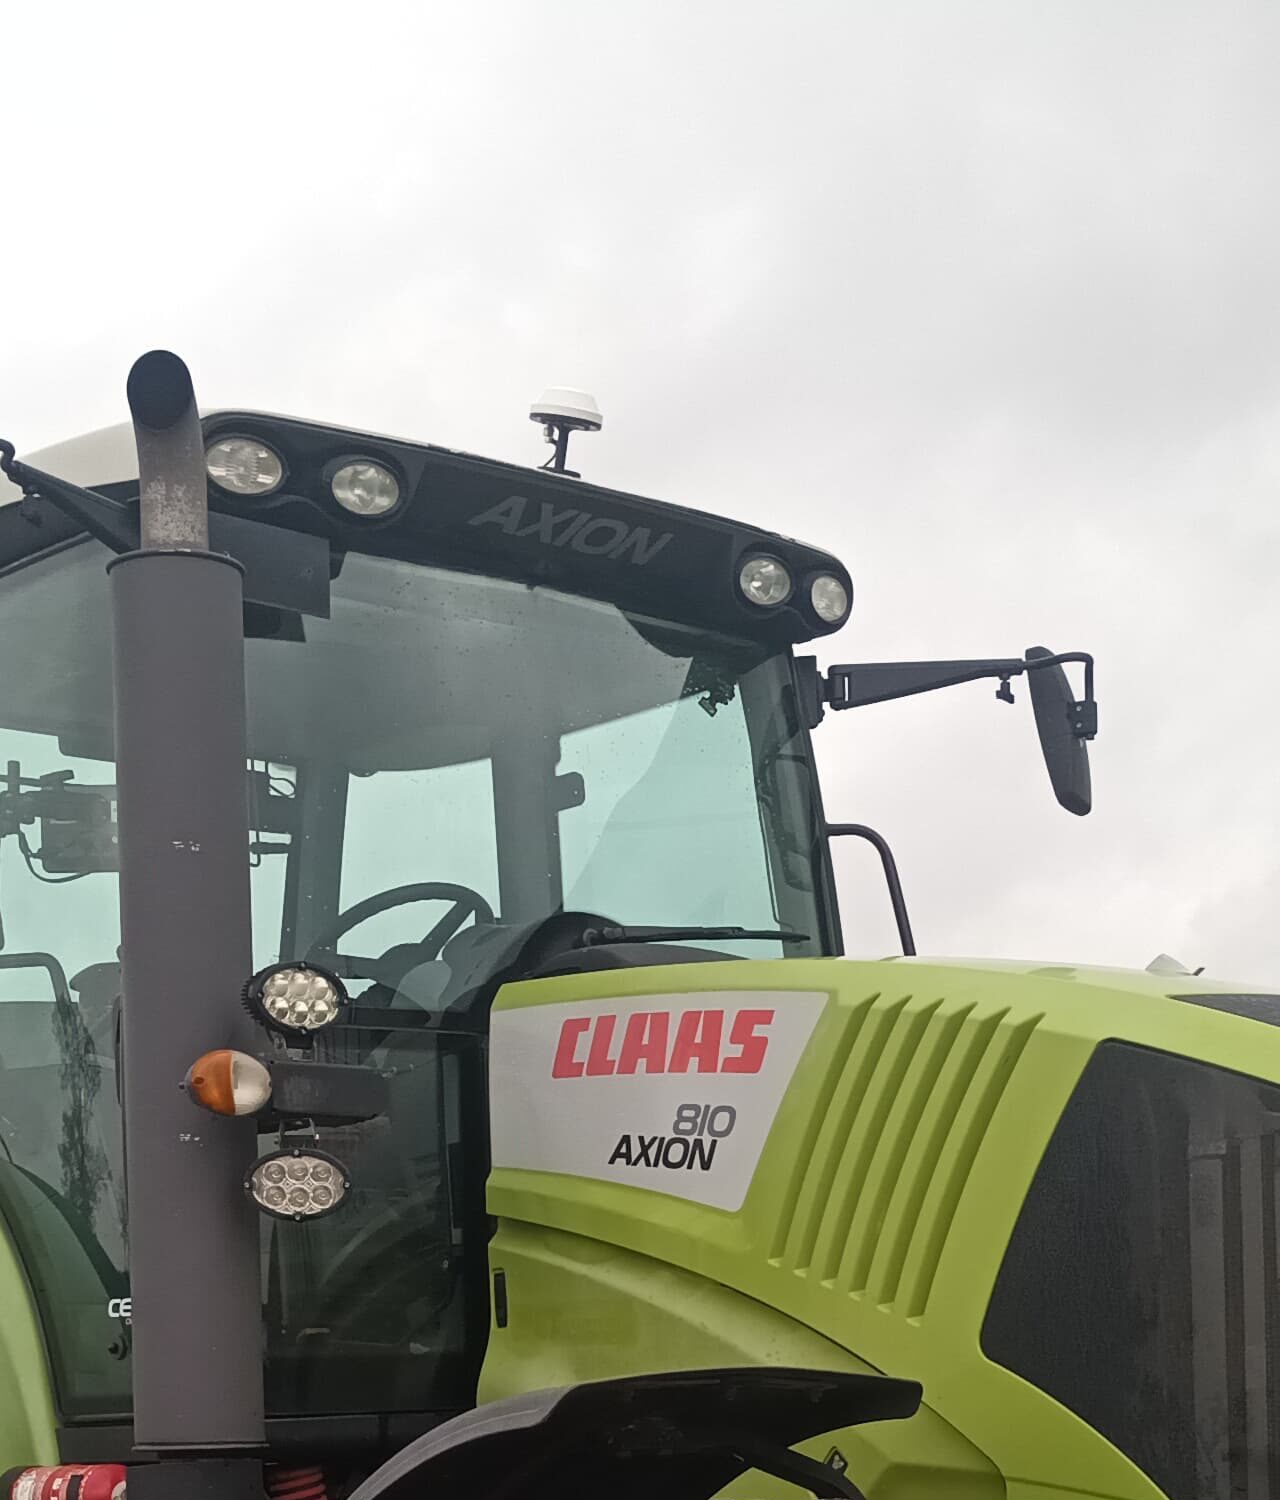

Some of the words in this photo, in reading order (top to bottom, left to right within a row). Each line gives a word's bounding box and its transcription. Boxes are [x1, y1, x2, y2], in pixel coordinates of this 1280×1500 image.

[467, 495, 674, 565] AXION
[552, 1009, 775, 1079] CLAAS
[672, 1103, 736, 1138] 810
[608, 1134, 717, 1171] AXION
